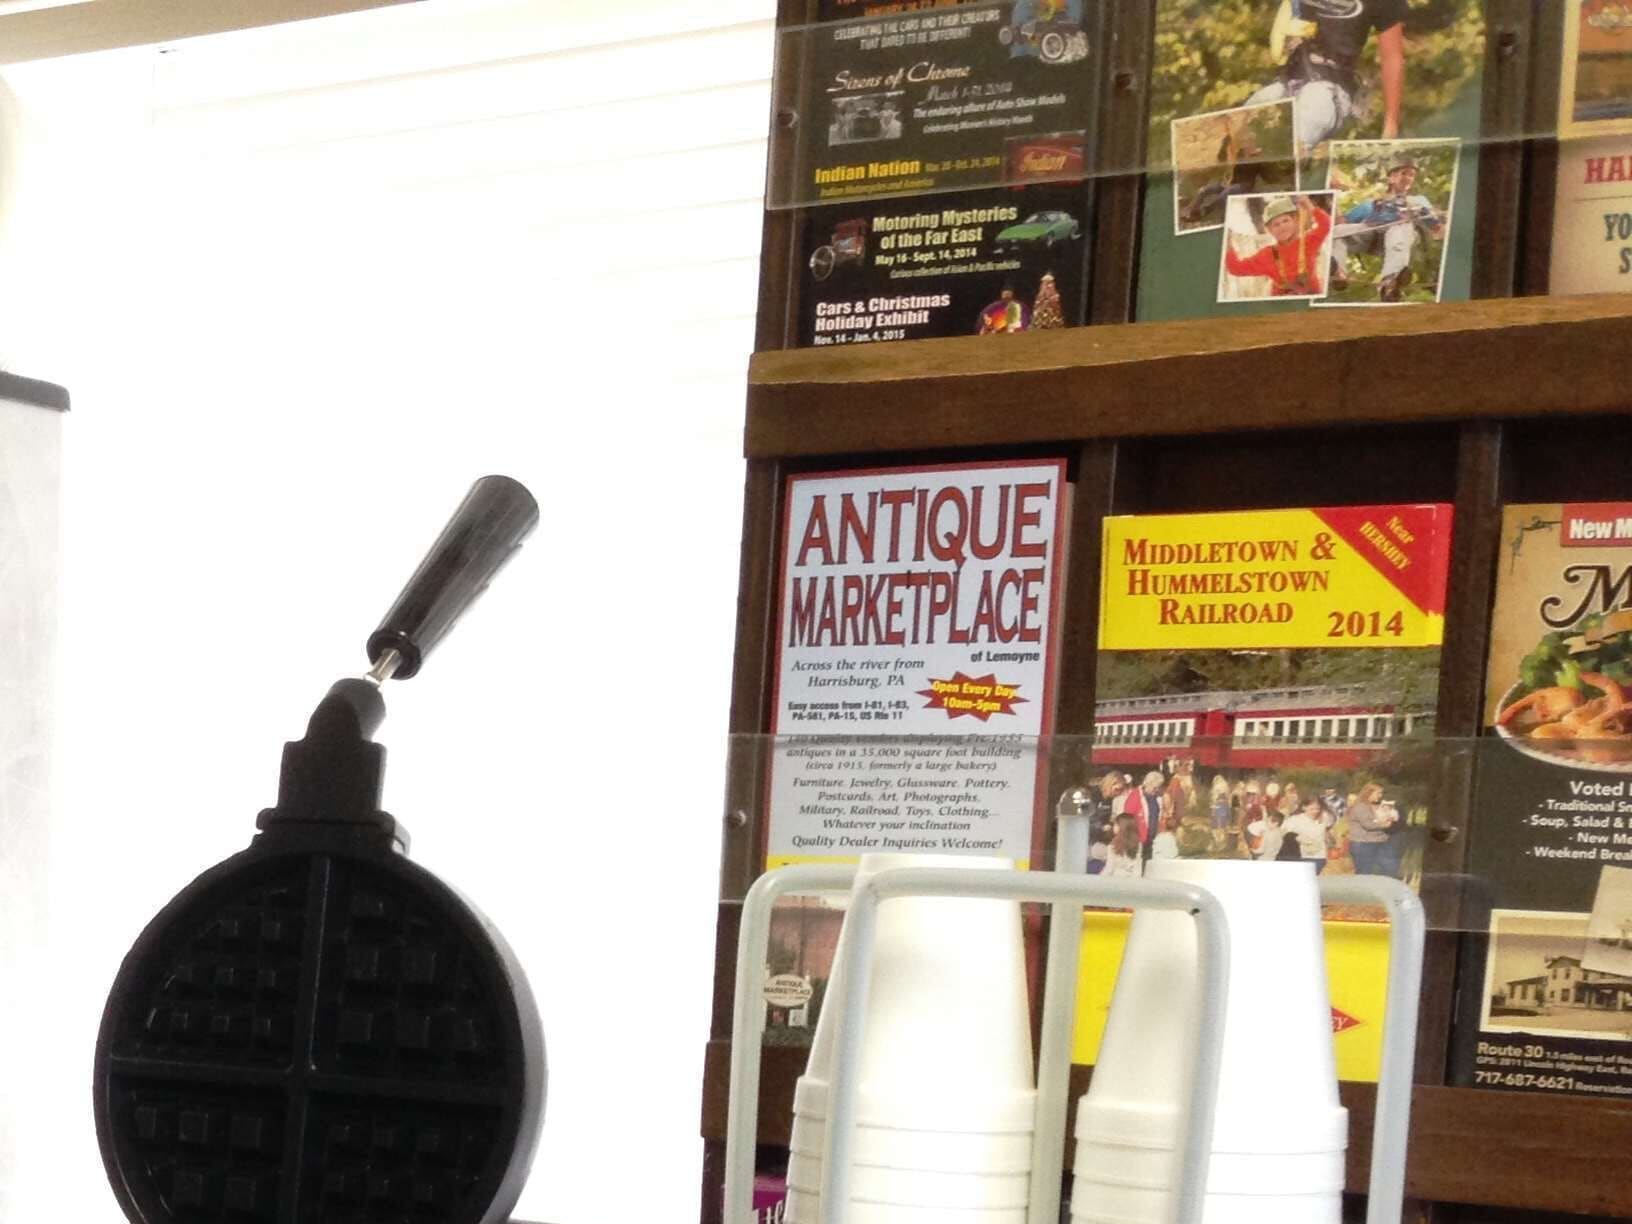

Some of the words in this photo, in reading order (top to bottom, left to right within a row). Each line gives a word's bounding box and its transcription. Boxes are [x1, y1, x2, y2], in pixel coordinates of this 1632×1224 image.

[826, 70, 880, 93] Sirens
[885, 68, 905, 89] of
[907, 62, 970, 82] Chrome
[815, 166, 865, 184] Indian
[869, 160, 920, 178] Nation
[873, 214, 939, 233] Motoring
[942, 206, 1017, 228] Mysteries
[881, 233, 897, 249] of
[898, 231, 921, 247] the
[925, 229, 947, 245] Far
[951, 226, 983, 243] East
[875, 255, 895, 266] May
[896, 253, 907, 263] 16
[913, 252, 936, 263] Sept.
[939, 250, 952, 260] 14,
[953, 247, 977, 258] 2014
[816, 301, 852, 317] Cars
[854, 300, 865, 313] &
[868, 294, 950, 311] Christmas
[816, 314, 873, 333] Holiday
[876, 310, 929, 327] Exhibit
[814, 333, 834, 345] Nov.
[835, 333, 847, 344] 14
[852, 331, 873, 343] Jan.
[884, 329, 905, 340] 2015
[795, 480, 1051, 568] ANTIQUE
[1385, 516, 1415, 545] Near
[1569, 518, 1612, 540] New
[1122, 538, 1299, 566] MIDDLETOWN
[1310, 532, 1336, 561] &
[1358, 521, 1412, 570] HERSHEY
[1127, 569, 1329, 596] HUMMELSTOWN
[789, 565, 1045, 647] MARKETPLACE
[1158, 598, 1294, 626] RAILROAD
[1328, 611, 1404, 638] 2014
[791, 660, 832, 671] Across
[836, 659, 856, 670] the
[860, 659, 889, 670] river
[894, 658, 925, 671] from
[971, 651, 983, 662] of
[987, 651, 1040, 664] Lemoyne
[808, 675, 882, 689] Harrisburg,
[887, 675, 905, 686] PA
[932, 681, 960, 693] Open
[962, 682, 992, 696] Every
[788, 702, 808, 712] Easy
[810, 702, 839, 710] access
[842, 701, 862, 709] from
[943, 697, 1001, 711] 10am-5pm
[859, 711, 872, 720] US
[786, 748, 832, 759] antiques
[835, 748, 846, 757] in
[849, 749, 856, 757] a
[903, 749, 942, 759] square
[946, 748, 968, 758] foot
[971, 747, 1022, 759] building
[926, 761, 952, 772] large
[1570, 781, 1624, 796] Voted
[1546, 799, 1615, 812] Traditional
[823, 819, 876, 829] Whatever
[879, 822, 906, 831] your
[909, 820, 971, 830] inclination
[1530, 814, 1568, 829] Soup,
[1573, 816, 1610, 828] Salad
[1613, 817, 1624, 828] &
[792, 835, 835, 848] Quality
[839, 836, 878, 847] Dealer
[882, 837, 937, 848] Inquiries
[941, 838, 1003, 848] Welcome!
[1577, 832, 1609, 843] New
[1534, 846, 1597, 859] Weekend
[1477, 1042, 1523, 1058] Route
[1524, 1045, 1544, 1058] 30
[1474, 1070, 1574, 1090] 717-687-6621
